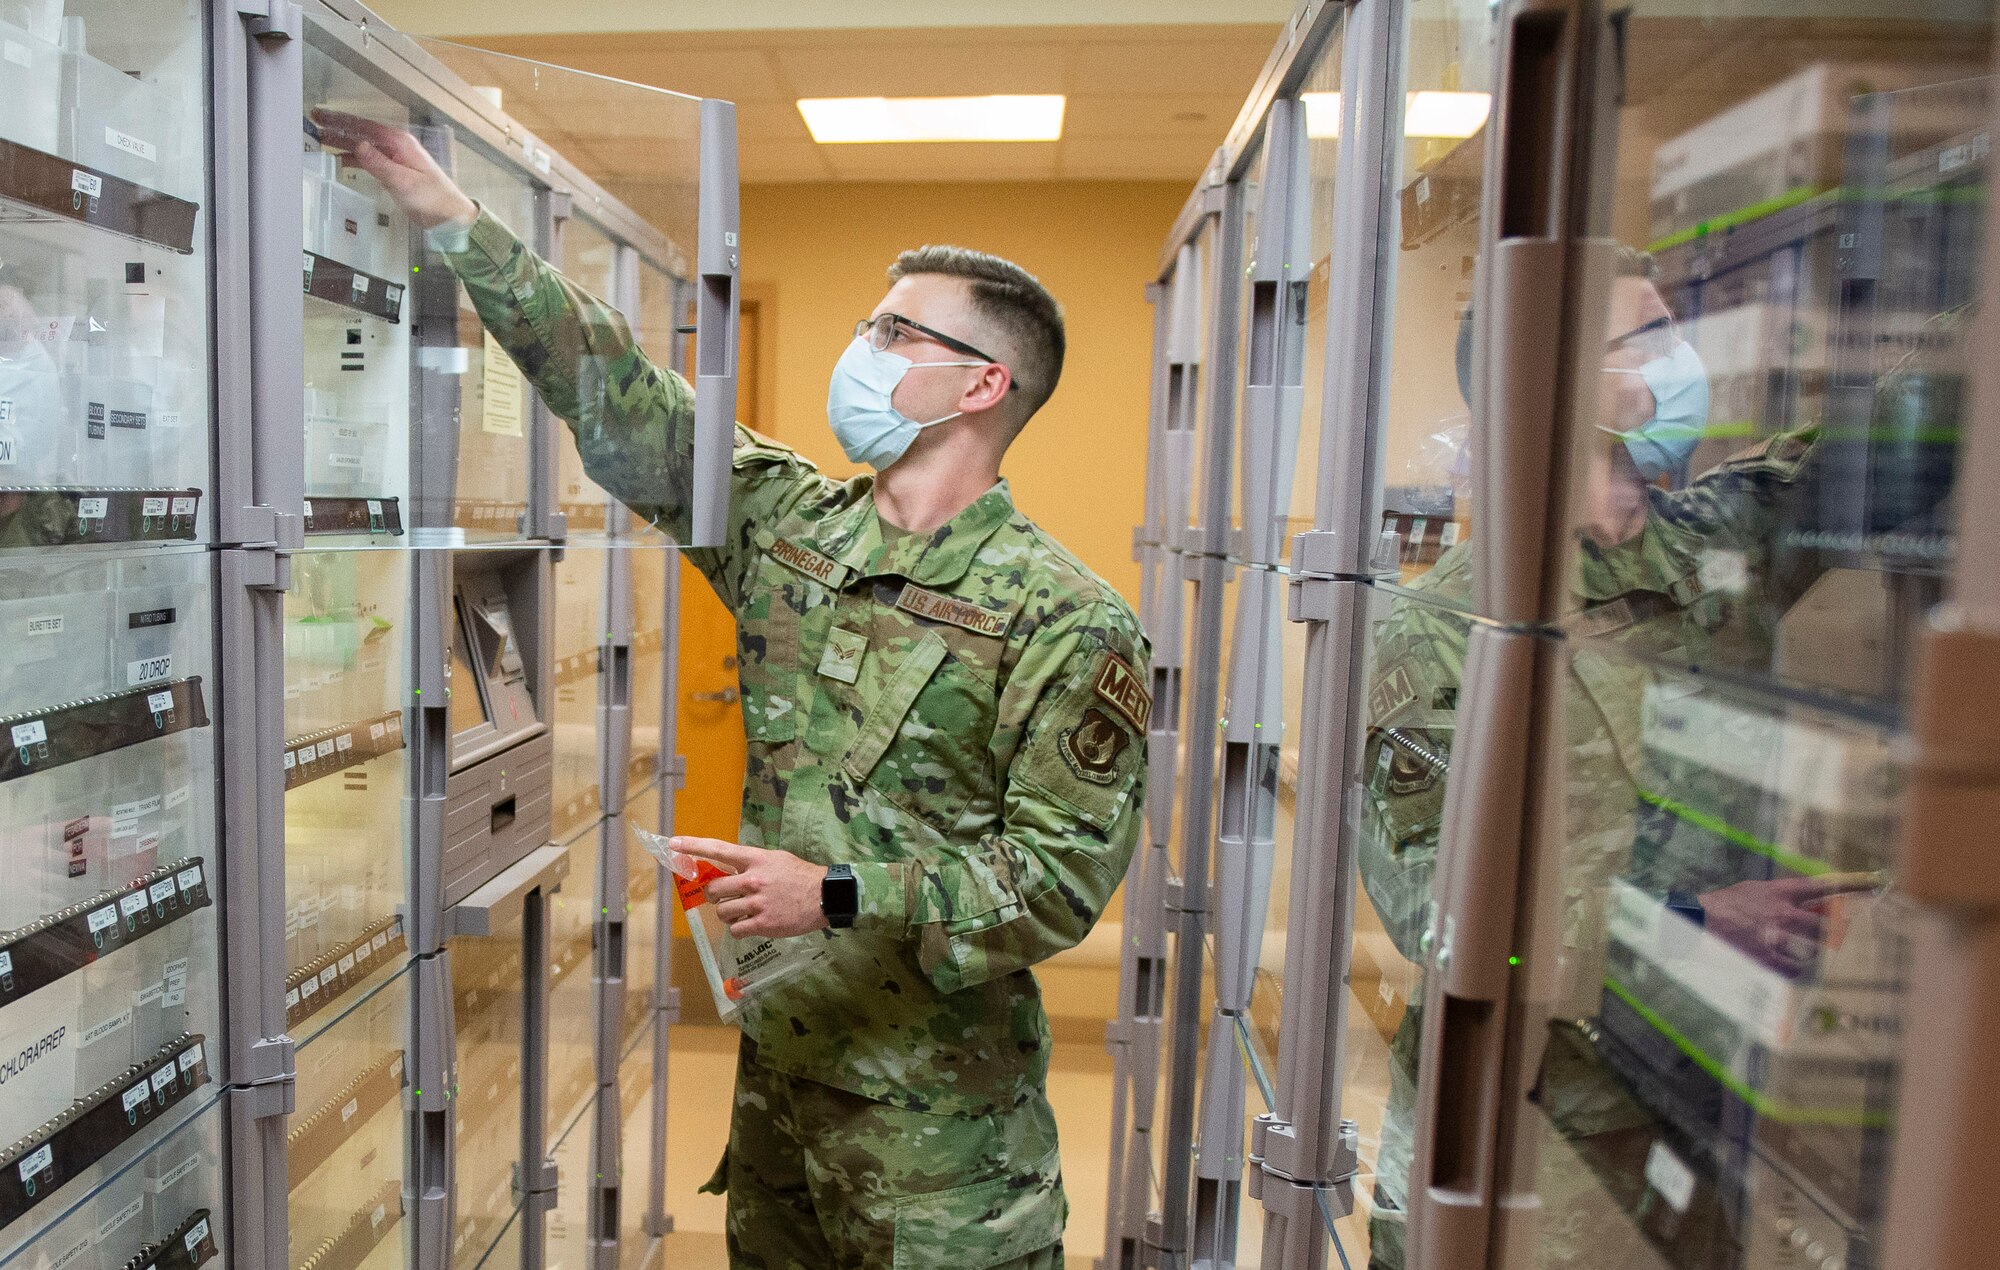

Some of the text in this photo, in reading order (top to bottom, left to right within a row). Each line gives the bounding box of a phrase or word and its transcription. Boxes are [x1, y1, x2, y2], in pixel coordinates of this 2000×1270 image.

[117, 134, 145, 154] CHECK VALVE
[88, 405, 105, 417] BLOOD
[110, 413, 135, 425] SECONDARY
[88, 424, 105, 437] TUBING
[771, 538, 835, 580] BRINEGAR
[29, 618, 62, 632] BURETTE SET
[152, 611, 167, 622] TUBING
[928, 600, 953, 620] AIR
[954, 606, 1005, 634] FORCE
[138, 658, 171, 681] 20 DROP
[1100, 662, 1148, 724] MED
[762, 948, 777, 960] BAG
[166, 961, 187, 974] IODOPHOR
[169, 978, 181, 987] PREP
[170, 993, 180, 1002] PAD
[85, 1032, 94, 1041] ART
[94, 1024, 109, 1037] BLOOD
[0, 1026, 66, 1085] CHLORAPREP
[161, 1173, 177, 1187] NEEDLE
[176, 1163, 190, 1176] SAFETY
[100, 1221, 116, 1236] NEEDLE
[116, 1210, 132, 1225] SAFETY
[62, 1244, 79, 1261] SAFETY
